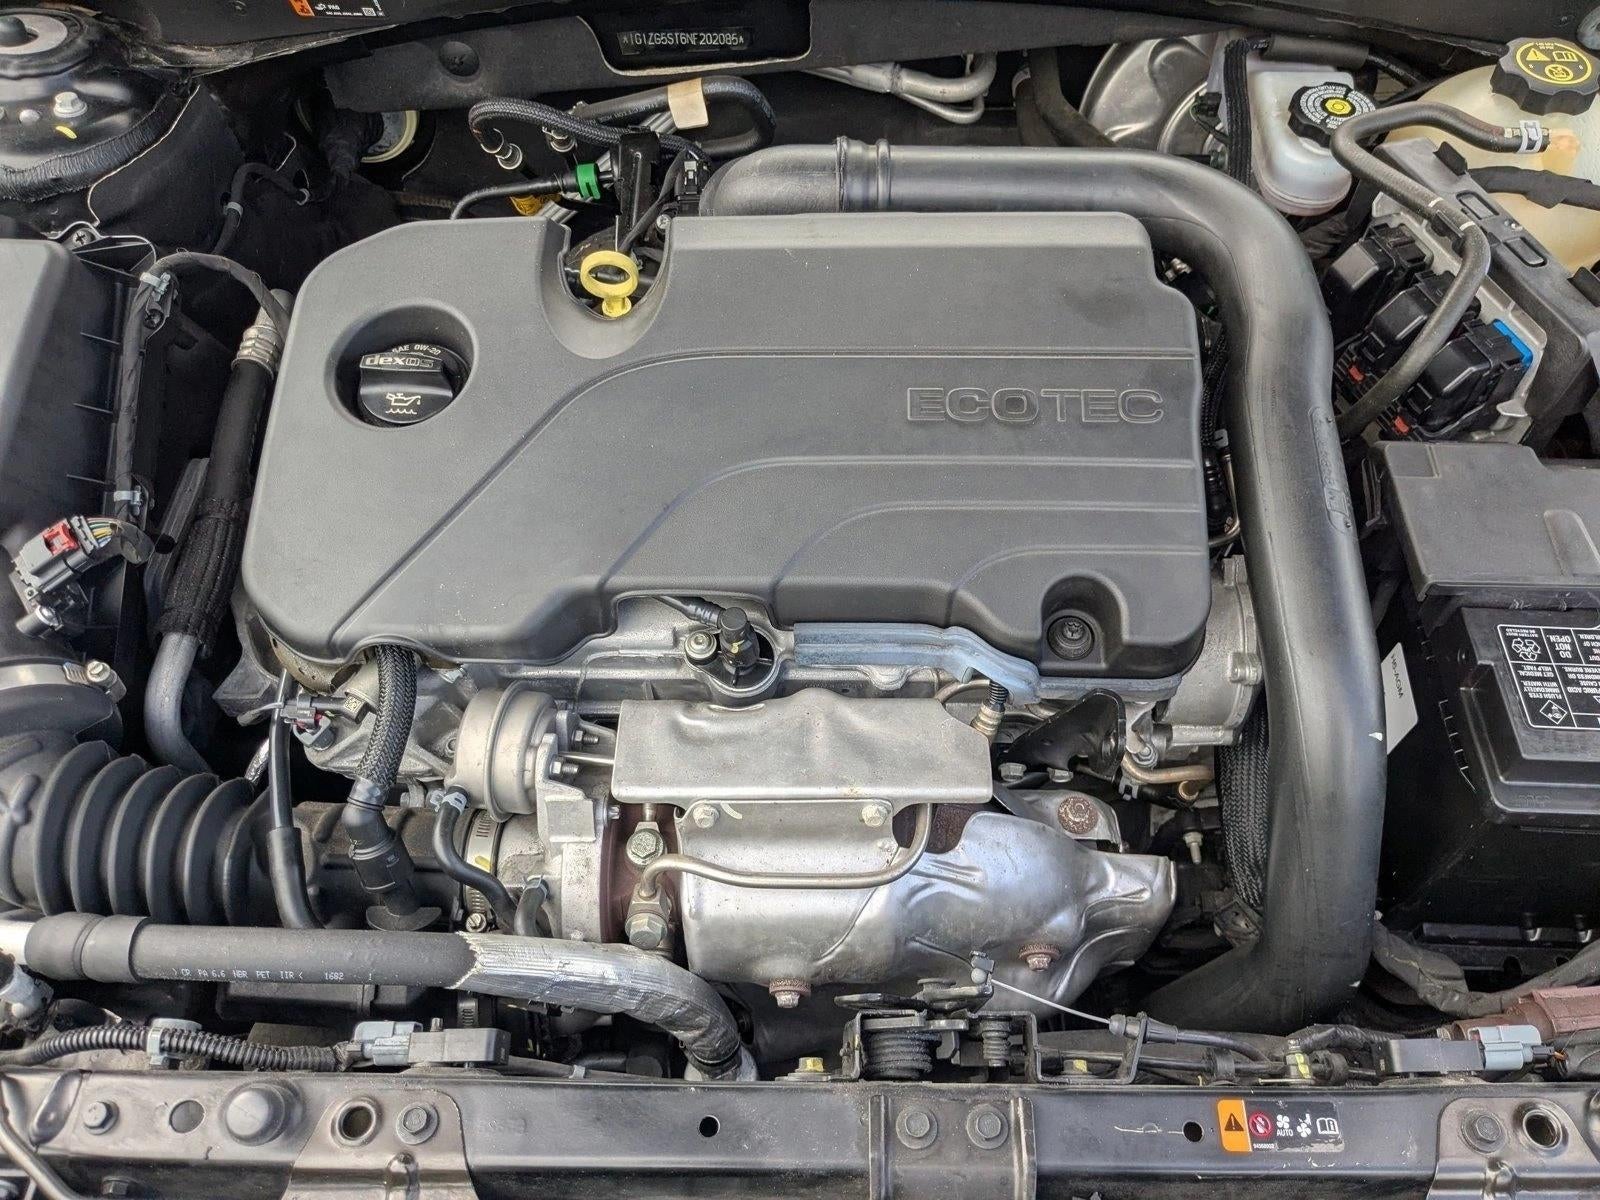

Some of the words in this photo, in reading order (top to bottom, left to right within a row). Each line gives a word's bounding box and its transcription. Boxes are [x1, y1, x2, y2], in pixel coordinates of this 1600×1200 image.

[365, 354, 435, 368] dexos
[907, 387, 1164, 424] ECOTEC
[1546, 634, 1571, 642] OPEN.
[256, 970, 270, 978] PET
